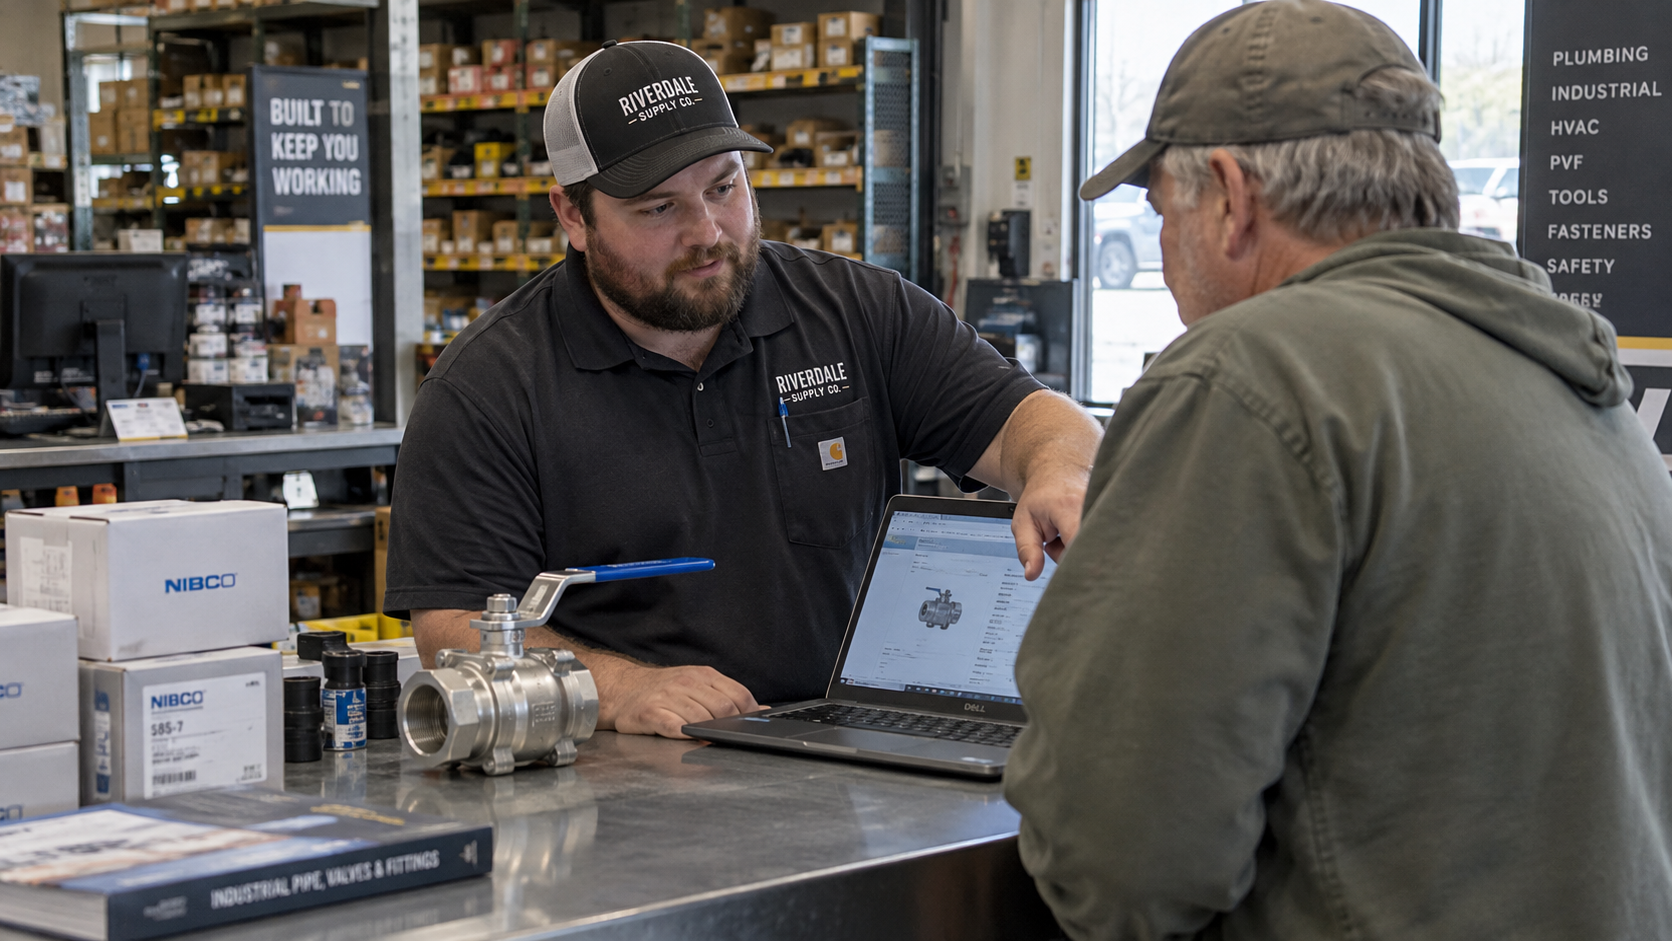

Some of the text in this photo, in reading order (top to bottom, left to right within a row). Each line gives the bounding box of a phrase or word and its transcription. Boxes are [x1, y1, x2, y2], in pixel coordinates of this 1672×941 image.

[1553, 46, 1648, 67] PLUMBING
[618, 76, 699, 117] RIVERDALE
[1552, 81, 1662, 101] INDUSTRIAL
[270, 97, 355, 127] BUILT TO
[638, 97, 695, 121] SUPPLY CO.
[1551, 118, 1599, 136] HVAC
[271, 132, 359, 161] KEEP YOU
[1550, 154, 1584, 170] PVF
[271, 166, 362, 196] WORKING
[1548, 188, 1609, 205] TOOLS
[1548, 223, 1652, 239] FASTENERS
[1547, 258, 1615, 274] SAFETY
[775, 362, 848, 394] RIVERDALE
[791, 384, 842, 403] SUPPLY CO.
[164, 573, 236, 594] NIBCO
[150, 690, 204, 710] NIBCO
[963, 702, 986, 713] DELL
[210, 876, 291, 910] INDUSTRIAL
[325, 861, 373, 888] VALVES
[373, 858, 385, 879] &
[385, 849, 440, 877] FITTINGS
